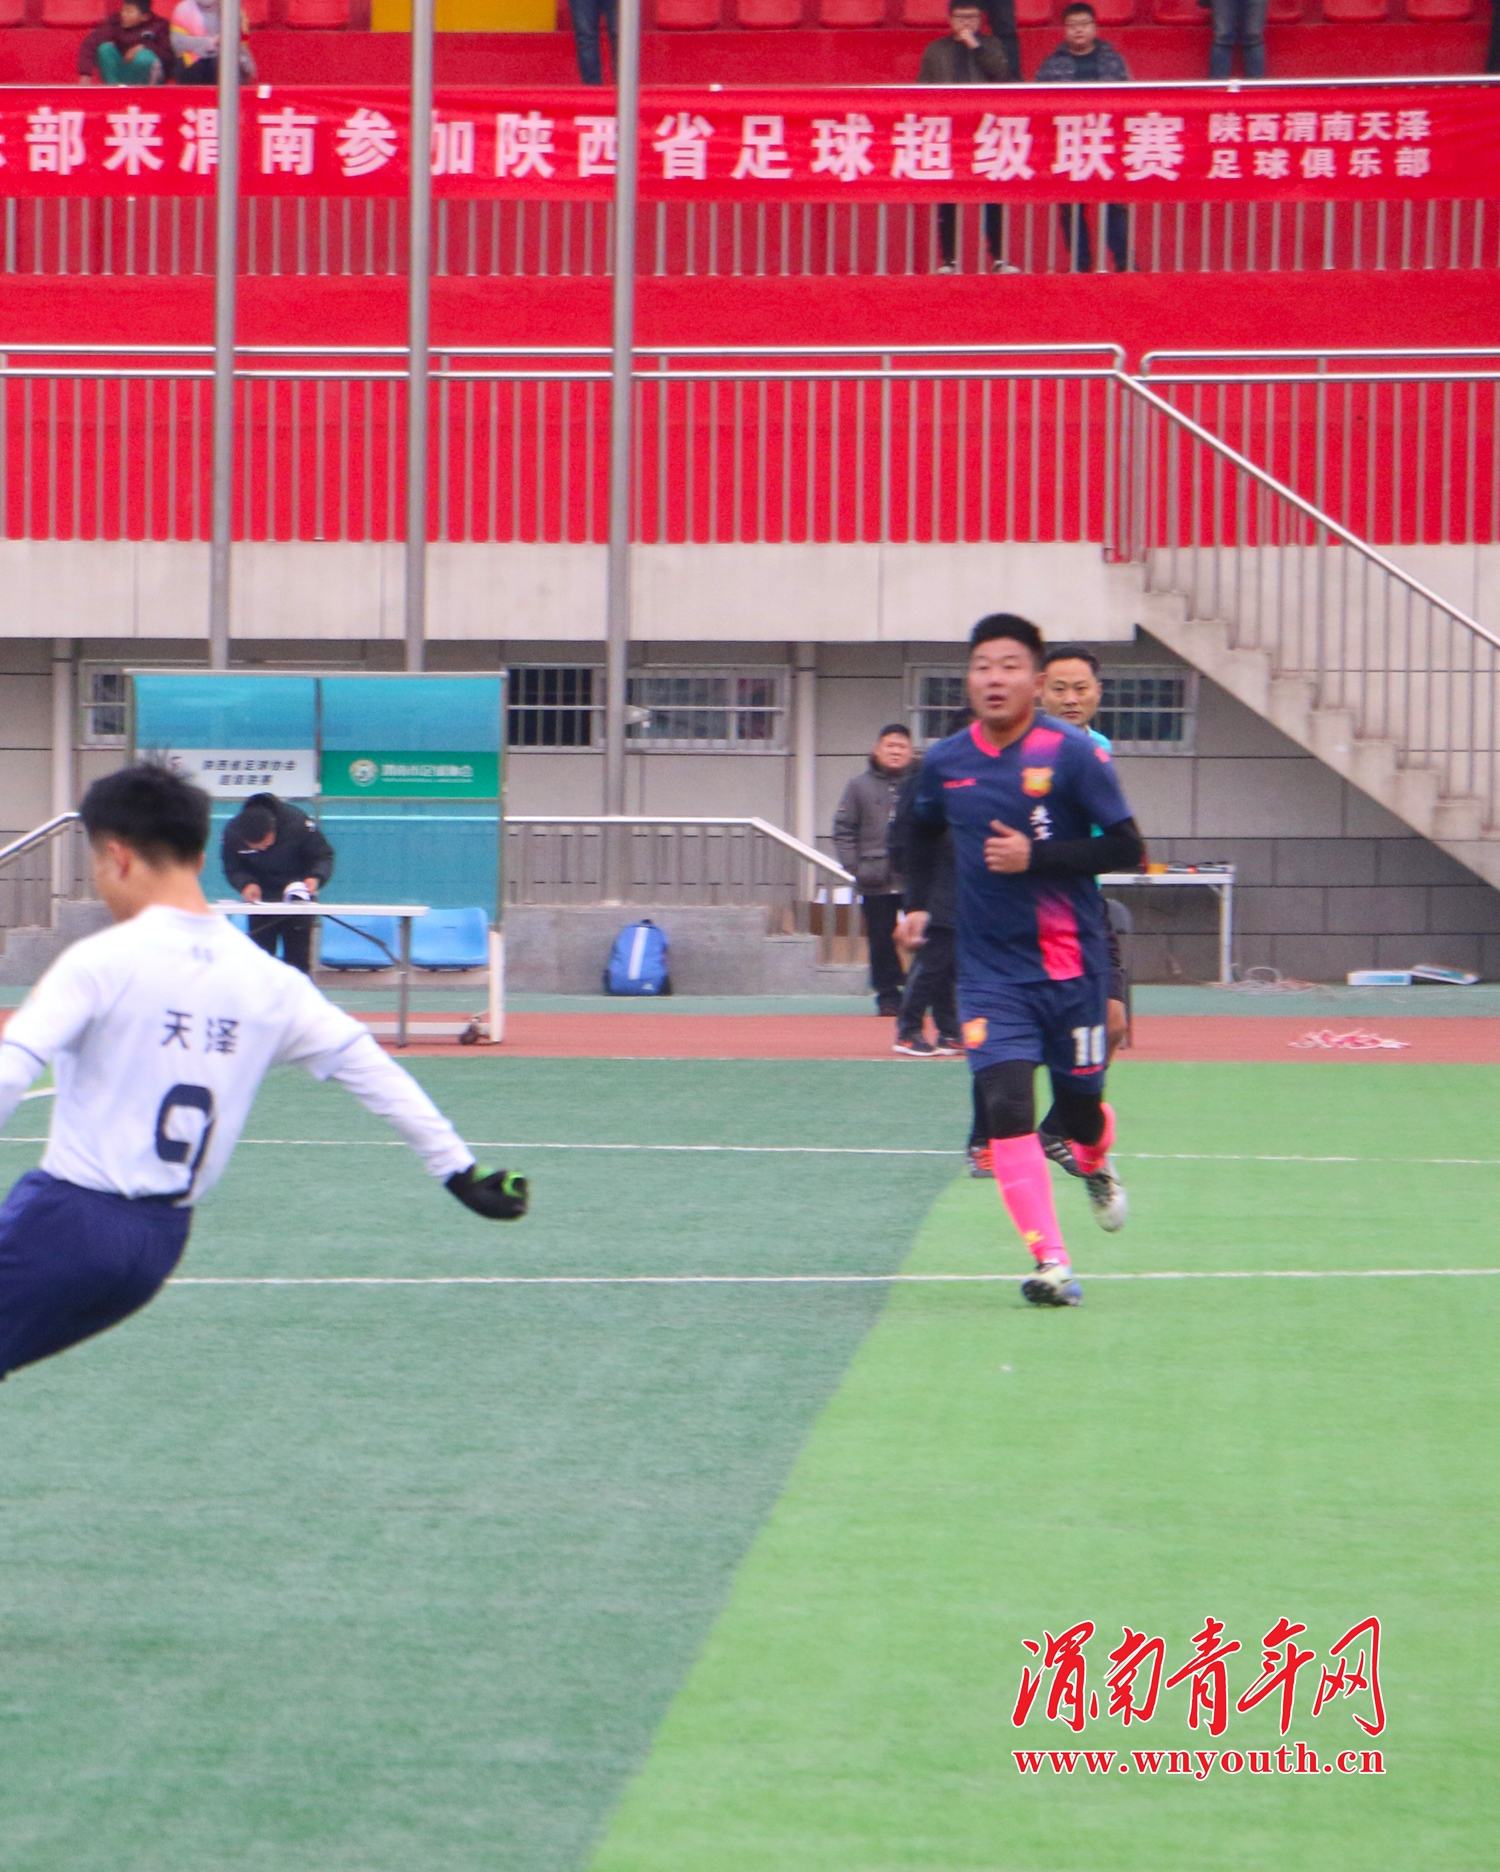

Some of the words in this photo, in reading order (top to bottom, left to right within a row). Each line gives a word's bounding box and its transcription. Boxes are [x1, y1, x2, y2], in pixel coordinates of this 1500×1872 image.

[1207, 110, 1432, 144] 陕西渭南天泽
[1206, 147, 1431, 180] 足球俱乐部
[161, 1010, 239, 1055] 天泽
[155, 1083, 216, 1199] 9
